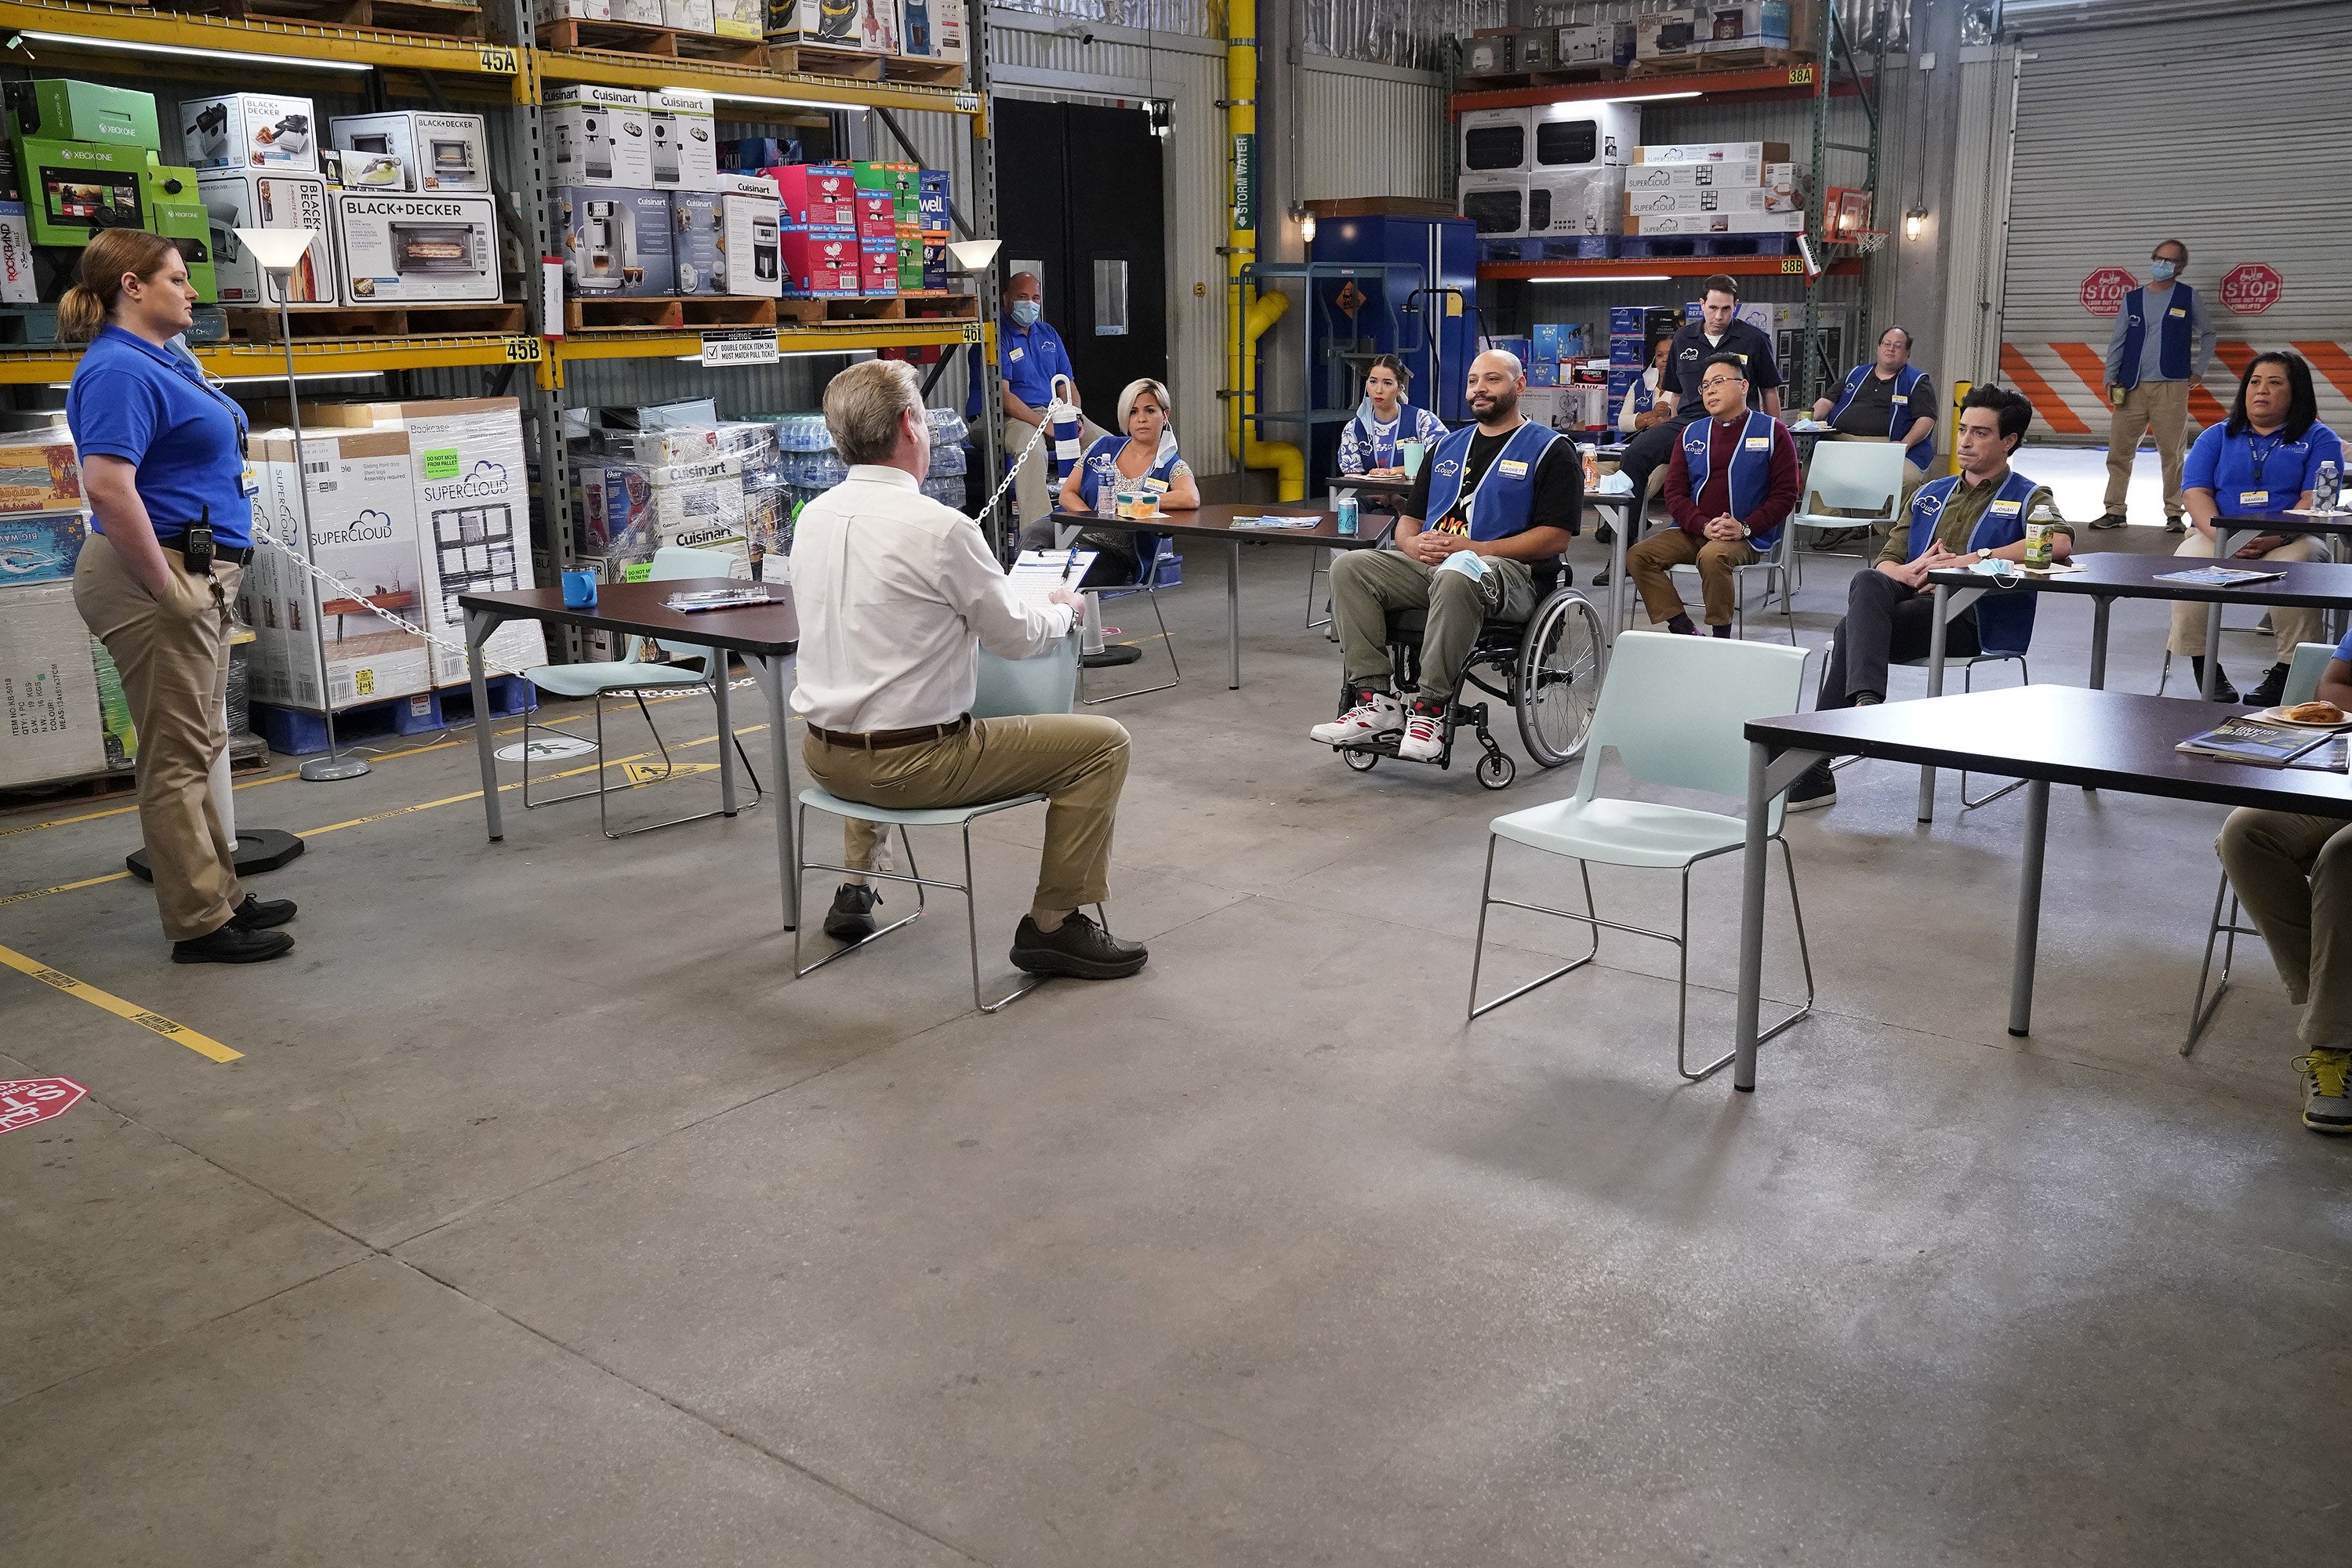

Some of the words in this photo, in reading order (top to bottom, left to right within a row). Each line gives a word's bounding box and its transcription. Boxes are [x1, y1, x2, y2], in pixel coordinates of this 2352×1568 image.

[481, 49, 517, 73] 45A
[1789, 69, 1812, 83] 38A
[543, 89, 579, 103] Cuisinart
[592, 89, 637, 103] Cuisinart
[661, 96, 704, 110] Cuisinart
[247, 100, 278, 109] BLACK+
[955, 97, 978, 111] 46A
[419, 119, 473, 129] BLACK+DECKER
[1236, 138, 1248, 175] WATER
[738, 183, 770, 194] Cuisinart
[1628, 179, 1671, 187] SUPERCLOUD
[637, 198, 666, 206] Cuisinart
[1237, 177, 1248, 214] STORM
[309, 185, 321, 232] BLACK+
[347, 202, 463, 216] BLACK+DECKER
[686, 199, 713, 208] Cuisinart
[919, 195, 944, 212] well
[1782, 260, 1803, 272] 38B
[2085, 285, 2132, 300] STOP
[2225, 281, 2277, 297] STOP
[507, 341, 540, 361] 45B
[410, 424, 450, 434] Bookcase
[606, 470, 622, 479] Oster
[670, 462, 727, 481] Cuisinart
[1501, 466, 1525, 474] GARRETT
[0, 488, 41, 498] GBOARD
[424, 480, 509, 502] SUPERCLOUD
[1147, 483, 1165, 492] JOANNA
[275, 468, 290, 546] SUPERCLOUD
[0, 533, 20, 542] WAV
[21, 532, 38, 541] BIG
[311, 526, 392, 546] SUPERCLOUD
[676, 526, 732, 547] Cuisinart
[34, 681, 43, 697] KGS
[19, 701, 26, 712] PC
[47, 699, 57, 731] COLOUR:
[11, 719, 20, 736] ITEM
[20, 718, 29, 735] QTY:
[31, 715, 39, 734] G.W.:
[40, 715, 49, 733] N.W.:
[2234, 725, 2279, 736] ISLAND
[2, 1084, 67, 1114] ST
